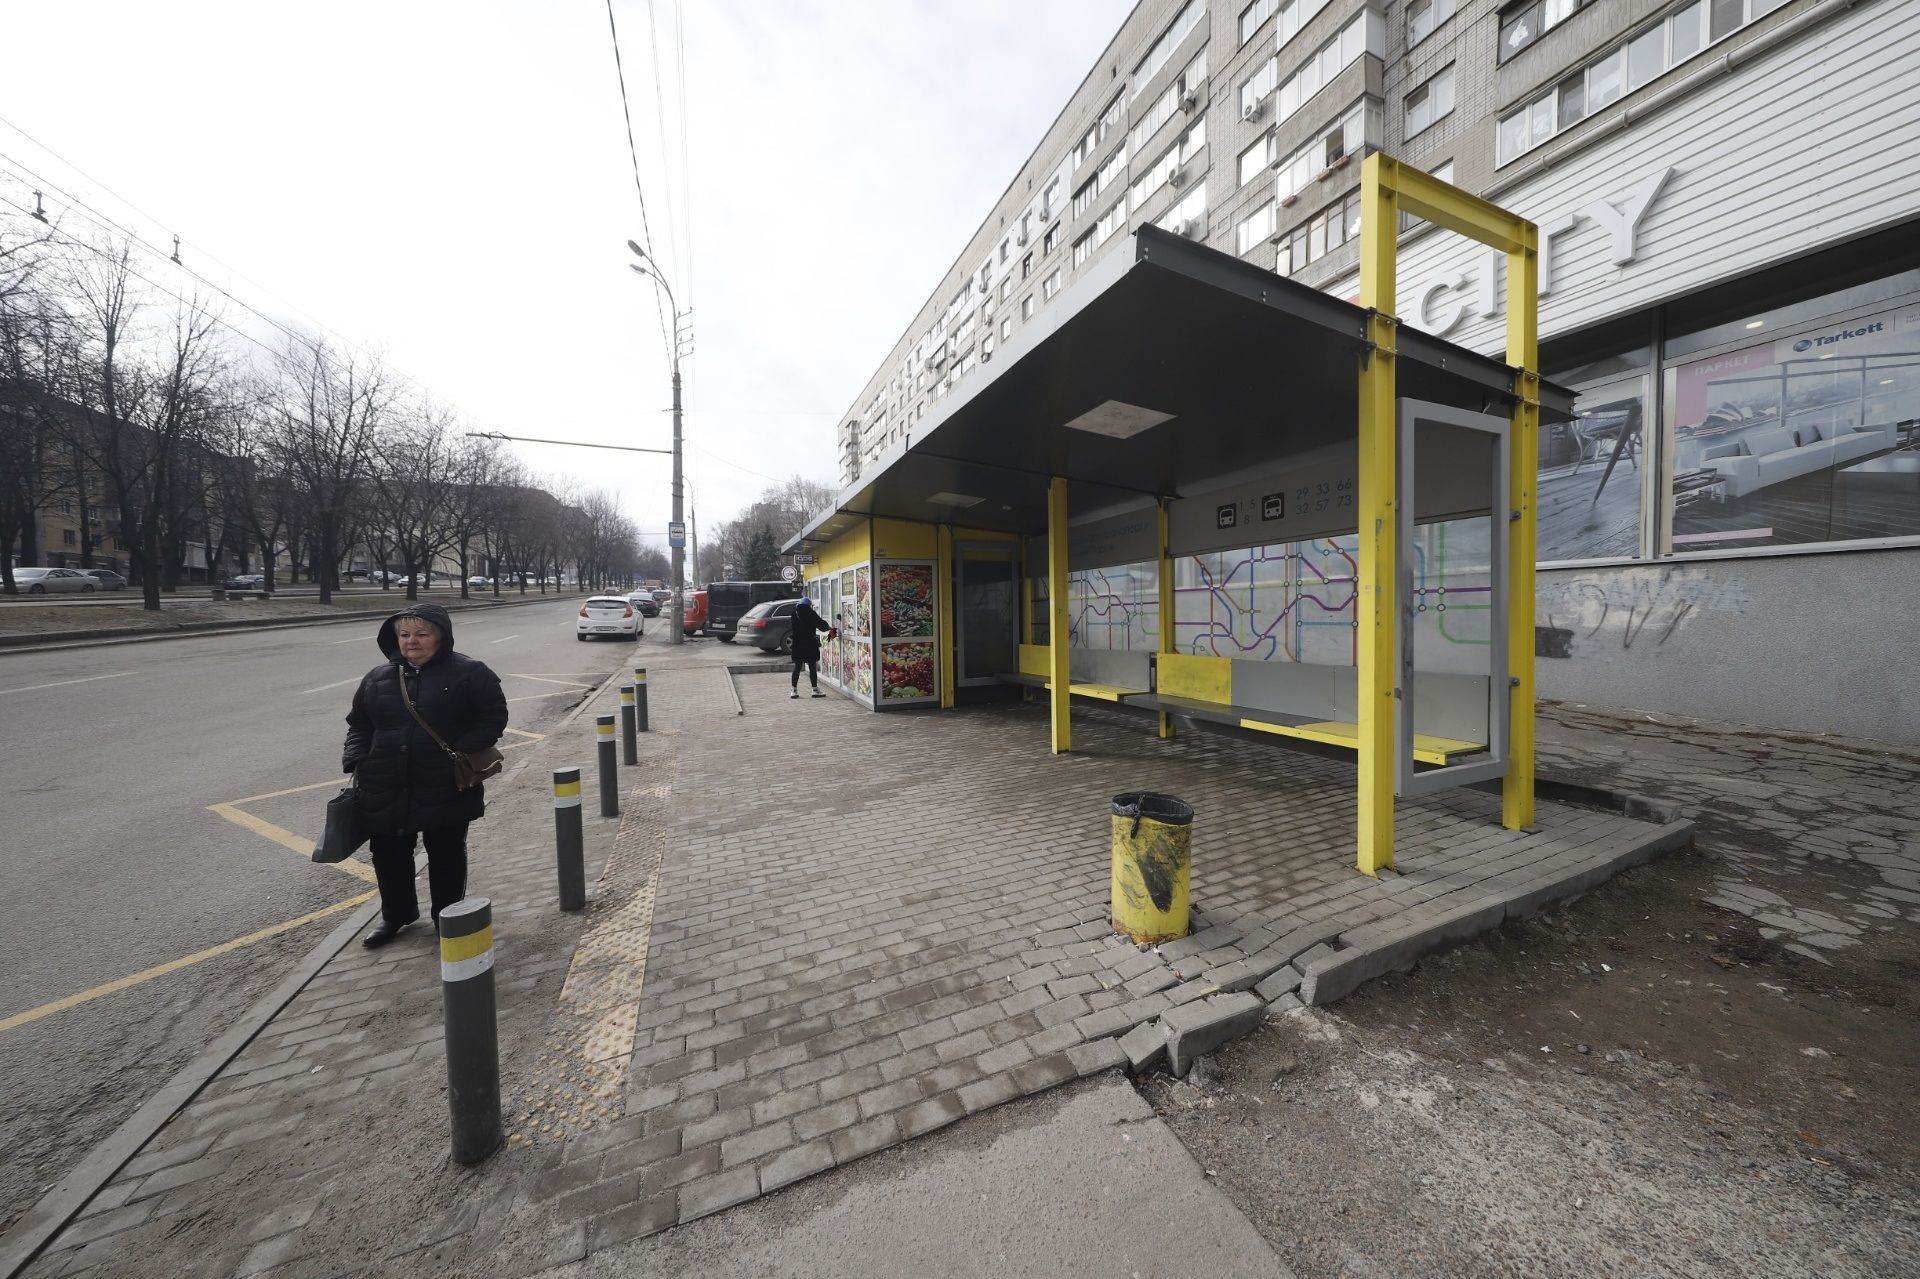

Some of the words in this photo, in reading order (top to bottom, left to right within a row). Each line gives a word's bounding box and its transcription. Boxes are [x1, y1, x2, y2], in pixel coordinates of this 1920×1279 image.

[1408, 166, 1677, 338] CITY
[1813, 321, 1884, 347] Tarkett
[1694, 353, 1751, 377] ПАРКЕТ
[1315, 482, 1330, 495] 33
[1337, 478, 1352, 491] 66
[1315, 498, 1329, 512] 57
[1337, 494, 1352, 508] 73
